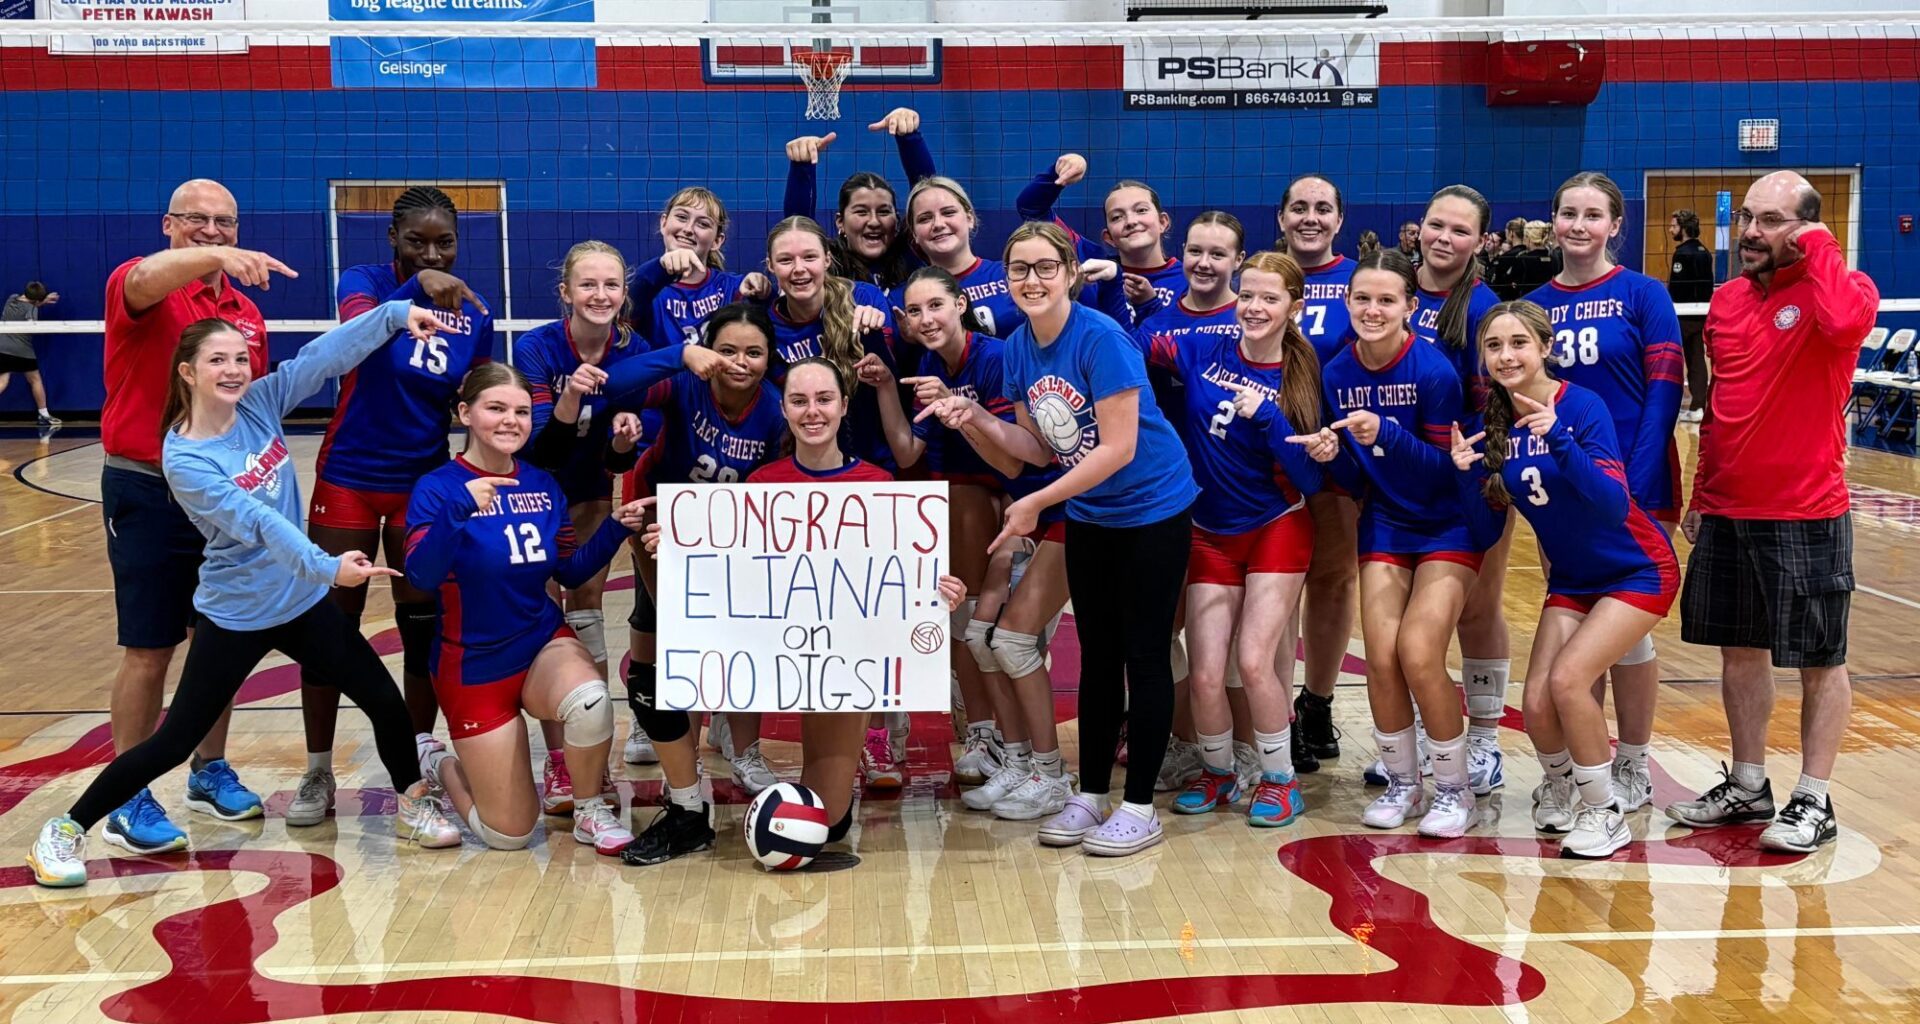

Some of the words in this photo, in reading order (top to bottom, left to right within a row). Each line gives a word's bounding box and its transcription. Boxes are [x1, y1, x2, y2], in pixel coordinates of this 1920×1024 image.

[82, 8, 136, 21] PETER
[143, 8, 213, 21] KAWASH
[113, 38, 138, 47] YARD
[142, 38, 206, 47] BACKSTROKE
[379, 61, 447, 78] Geisinger
[1157, 56, 1309, 80] PSBank
[1130, 93, 1226, 107] PSBanking.com
[1245, 92, 1330, 104] 866-746-1011
[1749, 127, 1773, 145] EXIT
[962, 280, 1008, 302] HIEFS
[1575, 298, 1623, 321] CHIEFS
[409, 335, 449, 375] 15
[1555, 326, 1599, 368] 38
[1337, 386, 1372, 410] LADY
[1378, 383, 1418, 407] CHIEFS
[1209, 400, 1238, 441] 2
[721, 433, 766, 461] CHIEFS
[1521, 466, 1549, 506] 3
[507, 492, 552, 514] CHIEFS
[670, 488, 948, 554] CONGRATS
[504, 523, 547, 565] 12
[685, 554, 938, 621] ELIANA!!
[783, 625, 831, 651] on
[665, 650, 756, 711] 500
[775, 654, 902, 712] DIGS!!
